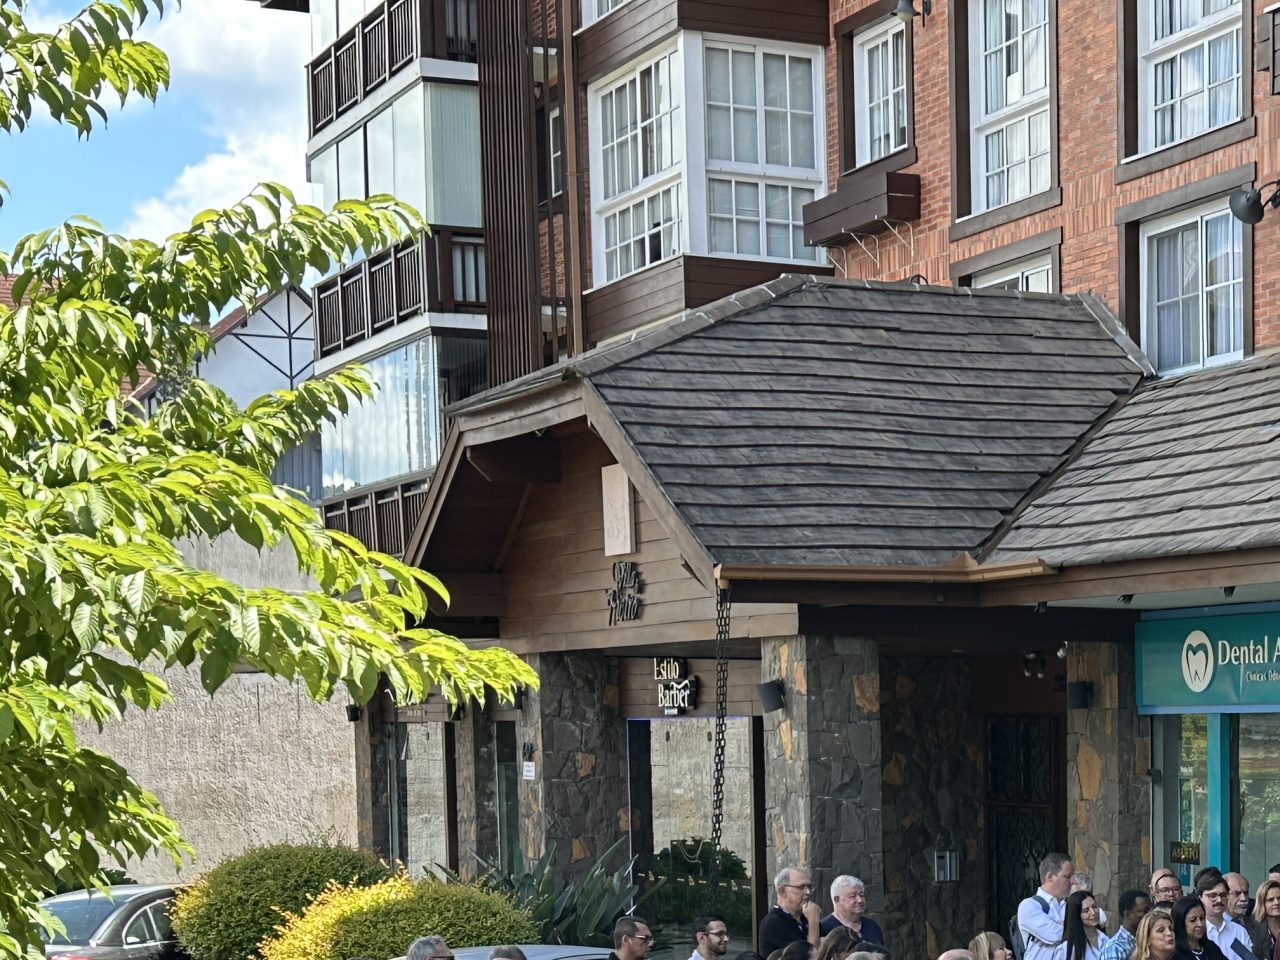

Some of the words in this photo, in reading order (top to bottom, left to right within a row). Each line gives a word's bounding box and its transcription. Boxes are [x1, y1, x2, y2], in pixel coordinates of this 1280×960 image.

[1218, 635, 1268, 665] Dental
[654, 657, 679, 680] Estilo
[658, 682, 690, 707] Barber
